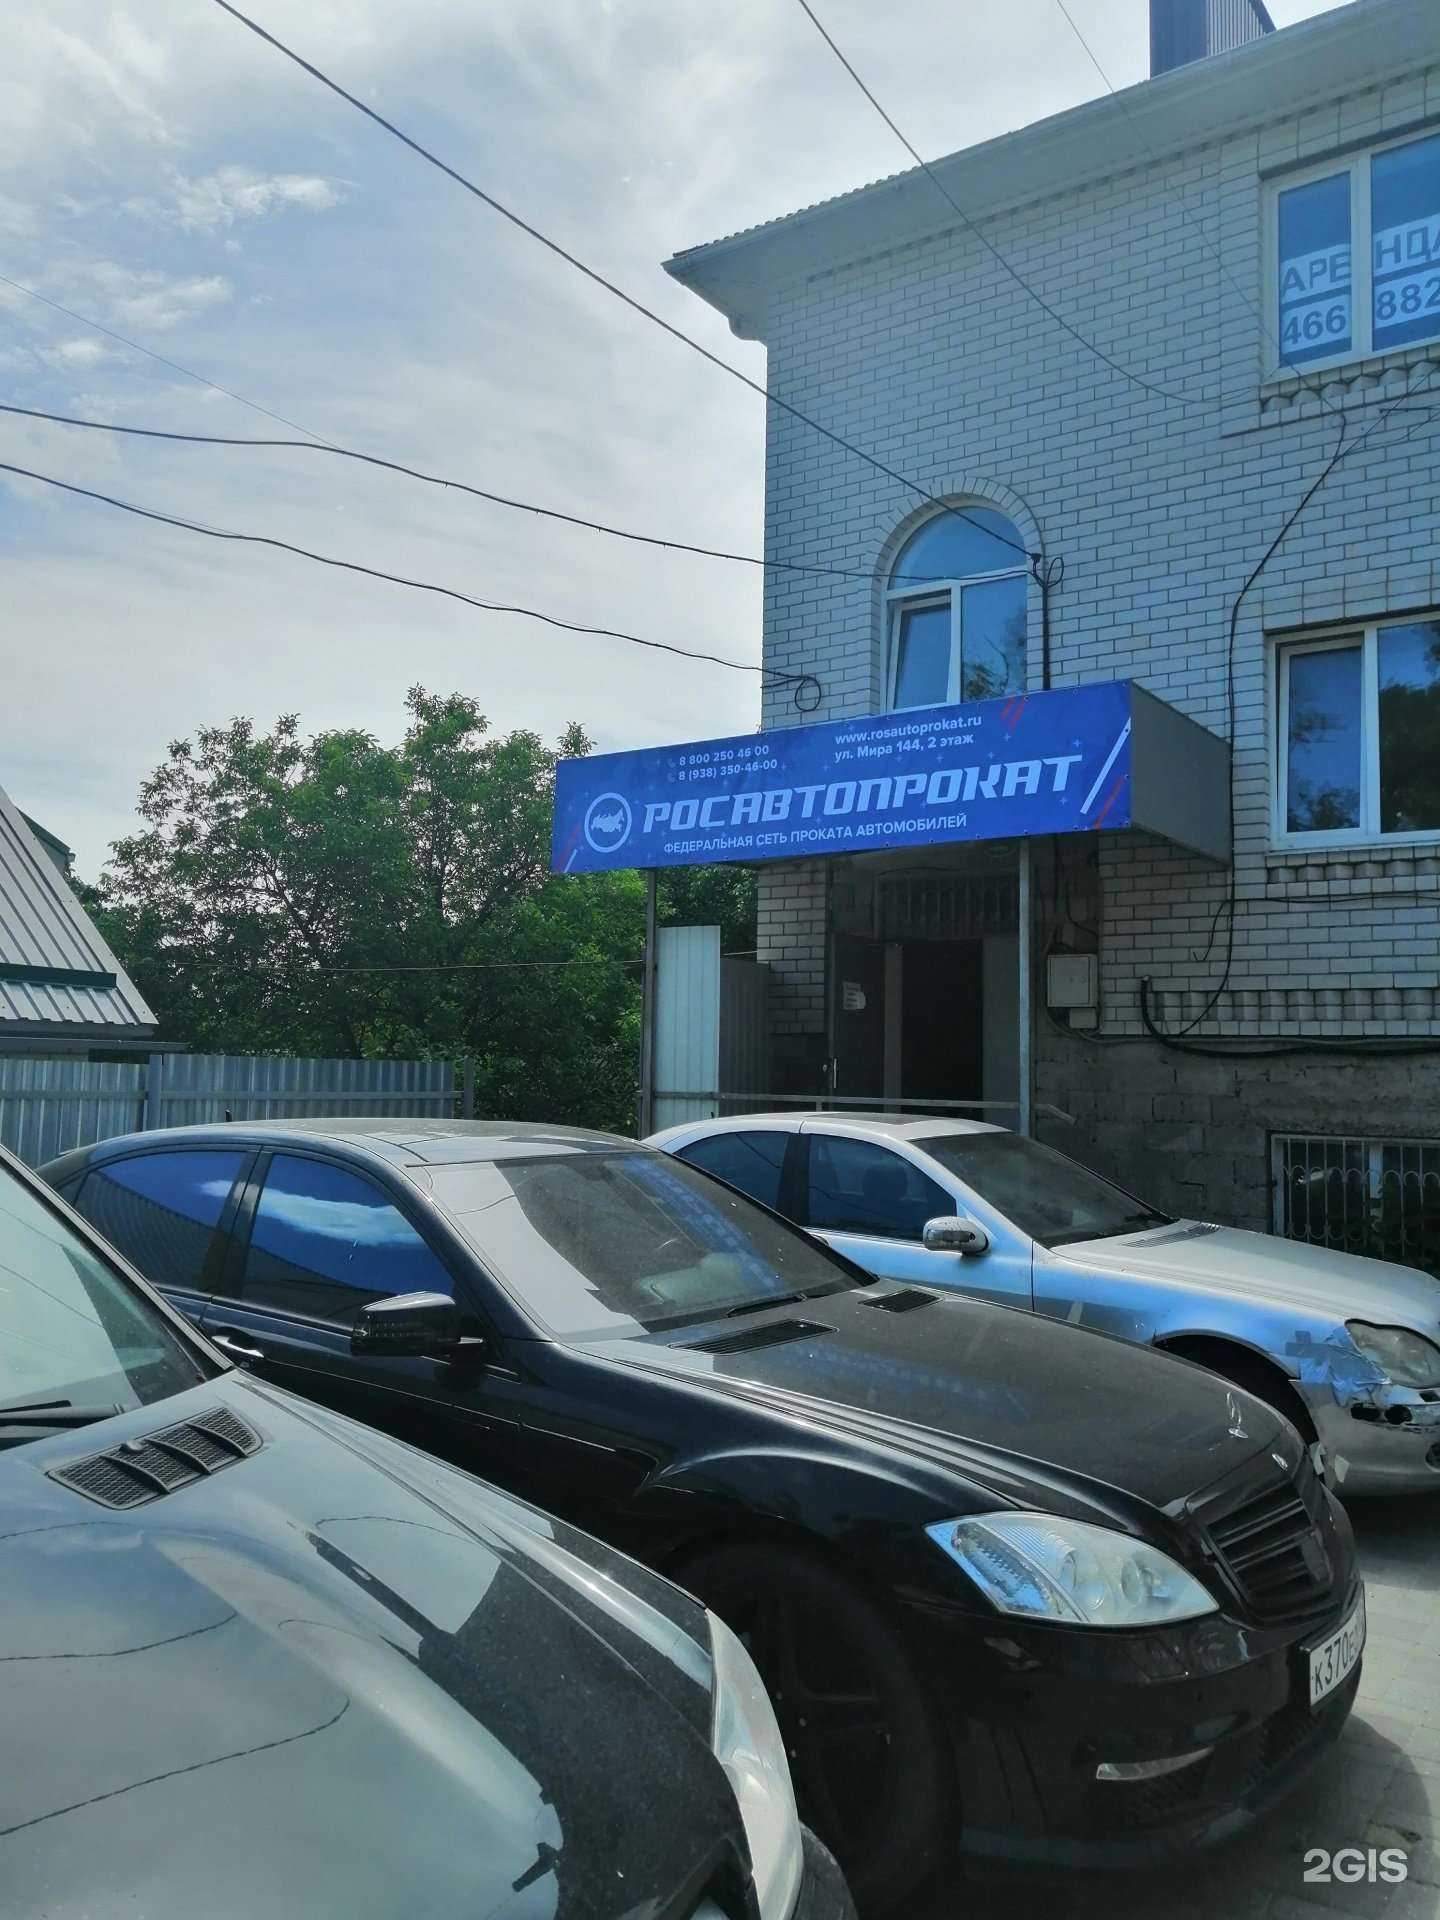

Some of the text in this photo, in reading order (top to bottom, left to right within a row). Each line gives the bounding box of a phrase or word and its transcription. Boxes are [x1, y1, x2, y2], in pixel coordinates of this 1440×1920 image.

[1282, 304, 1347, 345] 466
[835, 716, 982, 745] www.rosautoprokat.ru
[680, 756, 687, 767] 8
[688, 753, 711, 765] 800
[713, 750, 734, 762] 250
[754, 745, 770, 756] 00
[834, 734, 974, 764] ул. Мира 144, 2 этаж
[678, 770, 686, 781] 8
[688, 767, 718, 782] (938)
[643, 755, 1083, 833] РОСАВТОПРОКАТ
[663, 812, 968, 854] ФЕДЕРАЛЬНАЯ СЕТЬ ПРОКАТА АВТОМОБИЛЕЙ
